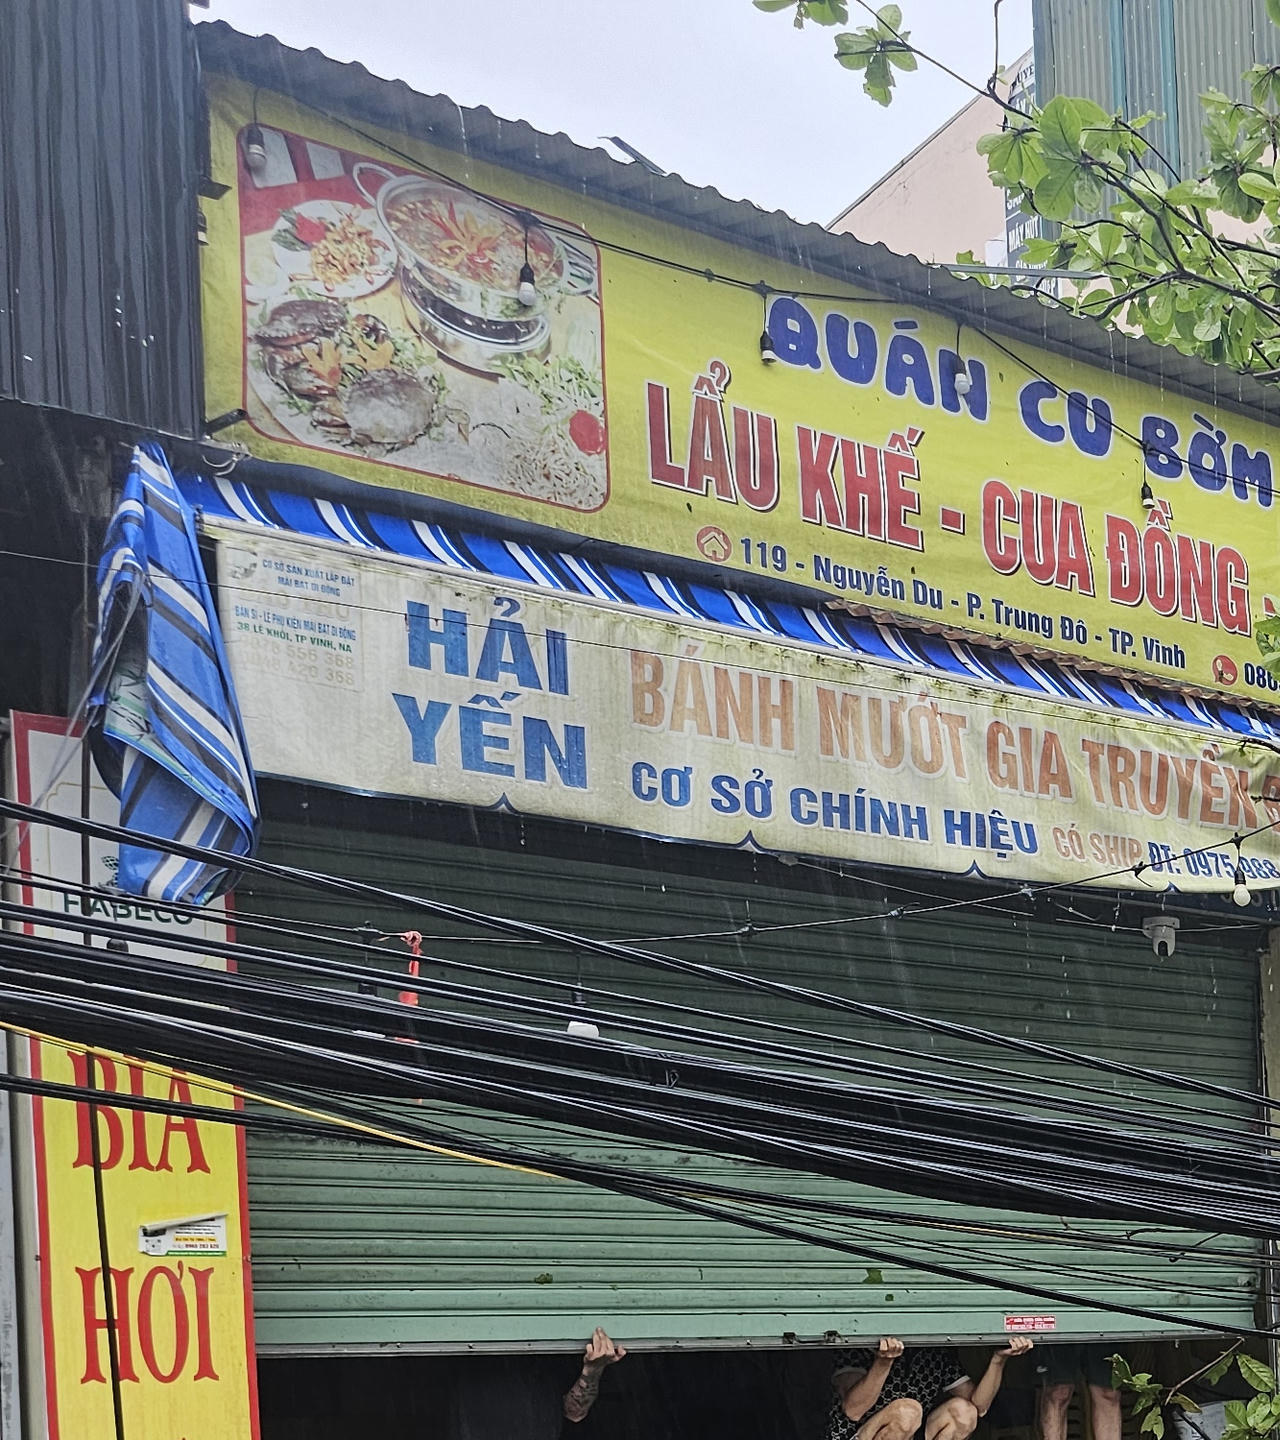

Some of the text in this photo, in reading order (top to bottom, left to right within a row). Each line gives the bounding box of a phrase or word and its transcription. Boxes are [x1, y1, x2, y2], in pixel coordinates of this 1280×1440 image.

[768, 297, 987, 421] QUÁN
[1019, 379, 1112, 457] CU
[1141, 412, 1273, 508] BỜM
[647, 360, 779, 513] LẨU
[796, 426, 925, 552] KHẾ
[940, 506, 966, 535] -
[980, 479, 1095, 597] CUA
[1105, 499, 1252, 637] ĐỒNG
[295, 633, 307, 644] TP
[406, 597, 569, 696] HẢI
[740, 537, 787, 572] 119
[813, 555, 905, 601] Nguyễn
[912, 579, 943, 611] Du
[966, 591, 985, 620] P.
[991, 598, 1054, 639] Trung
[1060, 614, 1088, 645] Đô
[1108, 627, 1137, 658] TP.
[1142, 636, 1186, 669] Vinh
[392, 691, 588, 790] YẾN
[630, 644, 795, 752] BÁNH
[816, 690, 969, 779] MƯỚT
[986, 720, 1072, 799] GIA
[1081, 738, 1258, 830] TRUYỀN
[632, 762, 693, 807] CƠ
[710, 768, 774, 820] SỞ
[789, 787, 930, 842] CHÍNH
[943, 809, 1039, 859] HIỆU
[1052, 822, 1083, 860] CÓ
[1089, 829, 1143, 867] SHIP
[1147, 841, 1182, 875] ĐT:
[1183, 847, 1236, 879] 0975
[67, 1047, 211, 1174] BIA
[75, 1258, 221, 1386] HƠI
